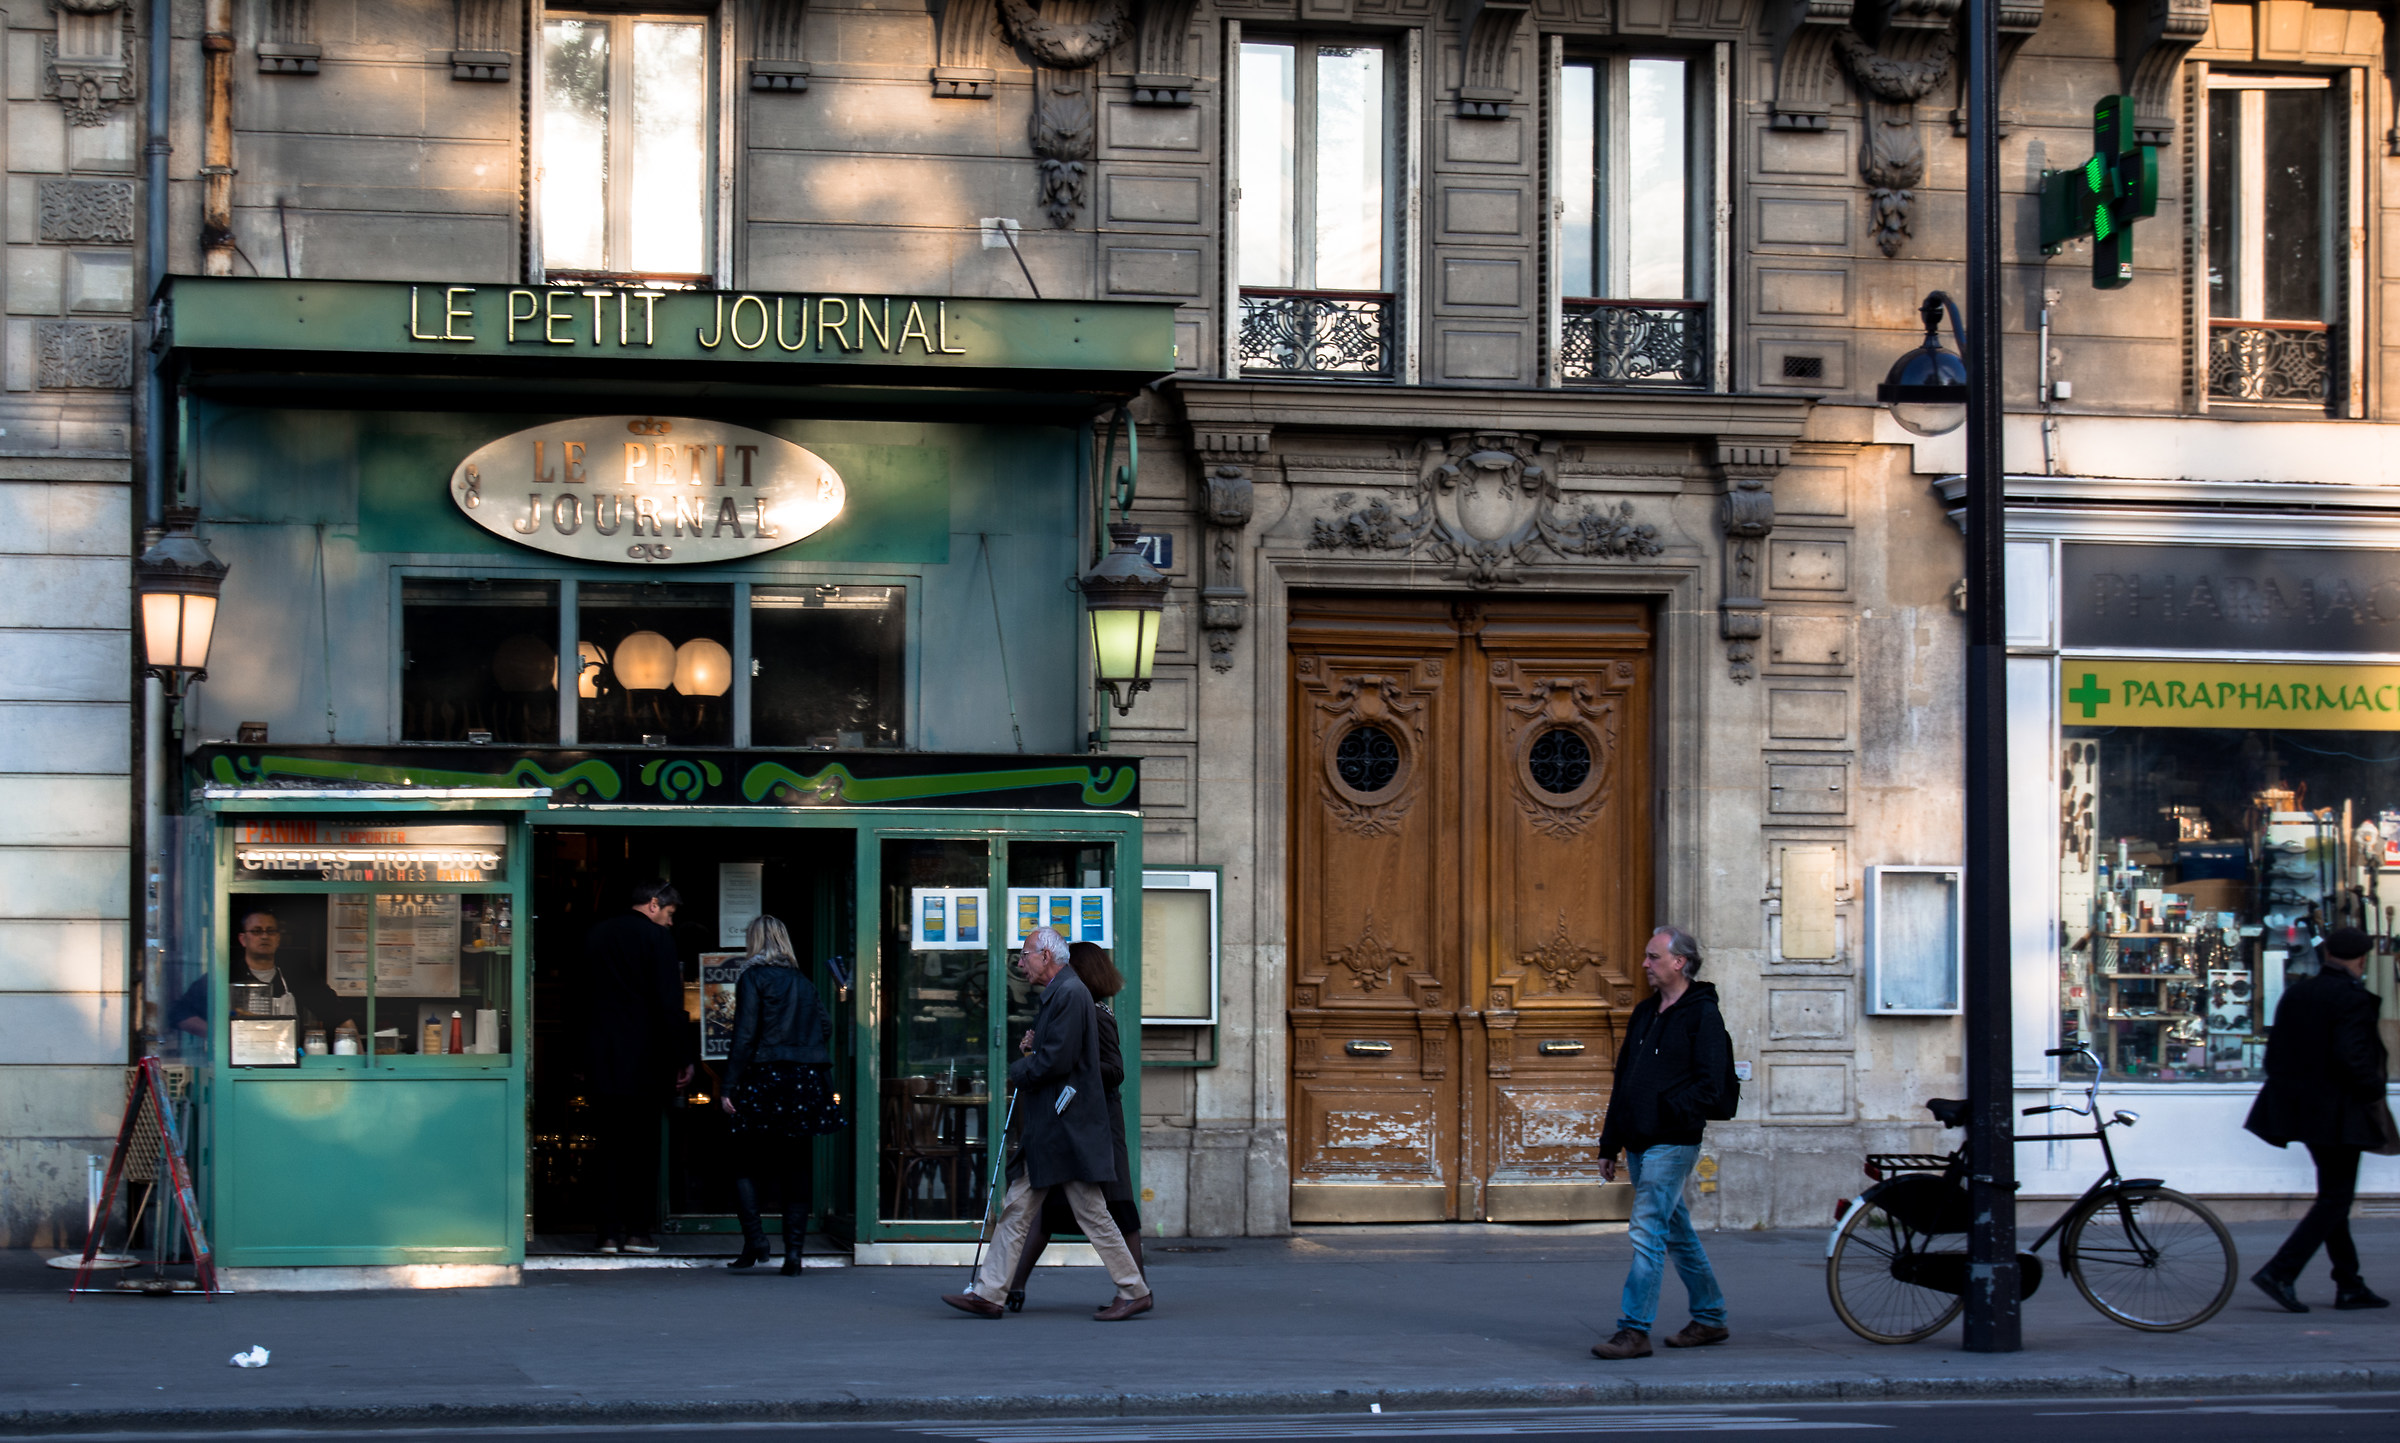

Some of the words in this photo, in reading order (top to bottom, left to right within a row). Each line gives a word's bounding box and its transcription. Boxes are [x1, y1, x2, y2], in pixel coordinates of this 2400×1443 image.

[410, 287, 476, 342] LE
[507, 290, 666, 347] PETIT
[698, 294, 967, 354] JOURNAL
[532, 440, 586, 484] LE
[622, 441, 760, 487] PETIT
[513, 492, 779, 540] JOURNAL
[1134, 536, 1163, 566] 71
[245, 819, 317, 844] PANINI
[340, 831, 406, 844] EMPORTER
[242, 850, 351, 871] CREPES
[372, 850, 426, 871] HOT
[437, 850, 498, 872] DOG
[321, 869, 427, 882] SANDWICHES
[437, 869, 480, 882] PANINI
